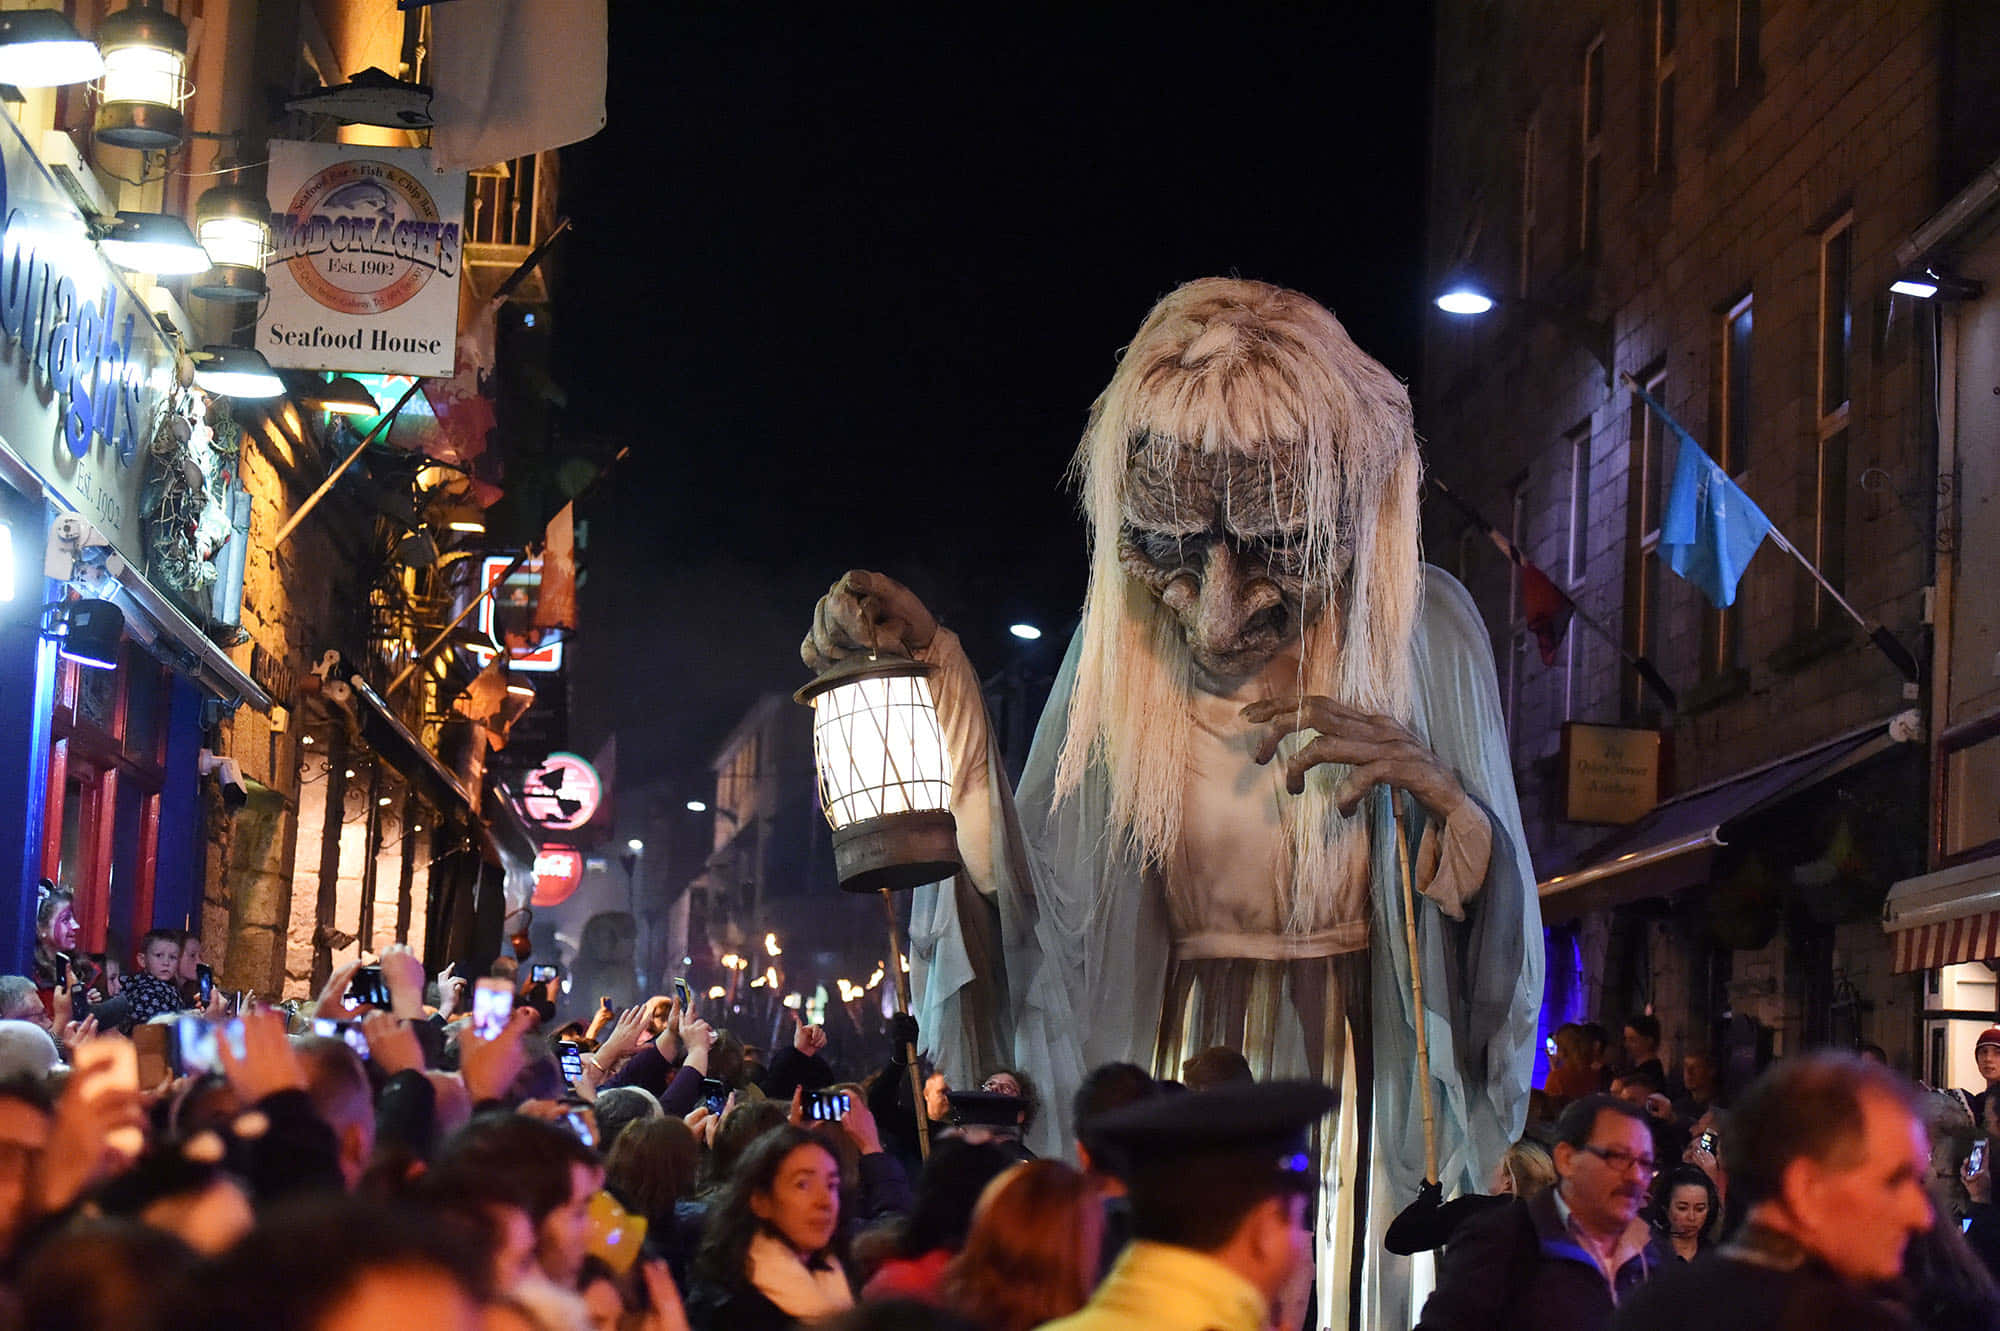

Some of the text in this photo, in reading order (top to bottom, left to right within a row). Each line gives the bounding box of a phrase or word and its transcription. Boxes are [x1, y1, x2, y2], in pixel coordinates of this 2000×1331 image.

[360, 165, 383, 177] Fish
[398, 177, 421, 199] Chip
[421, 197, 433, 217] Bar
[328, 258, 394, 276] Est. 1902
[0, 144, 139, 469] onagh's
[270, 323, 441, 355] Seafood House
[77, 461, 120, 530] Est. 1902
